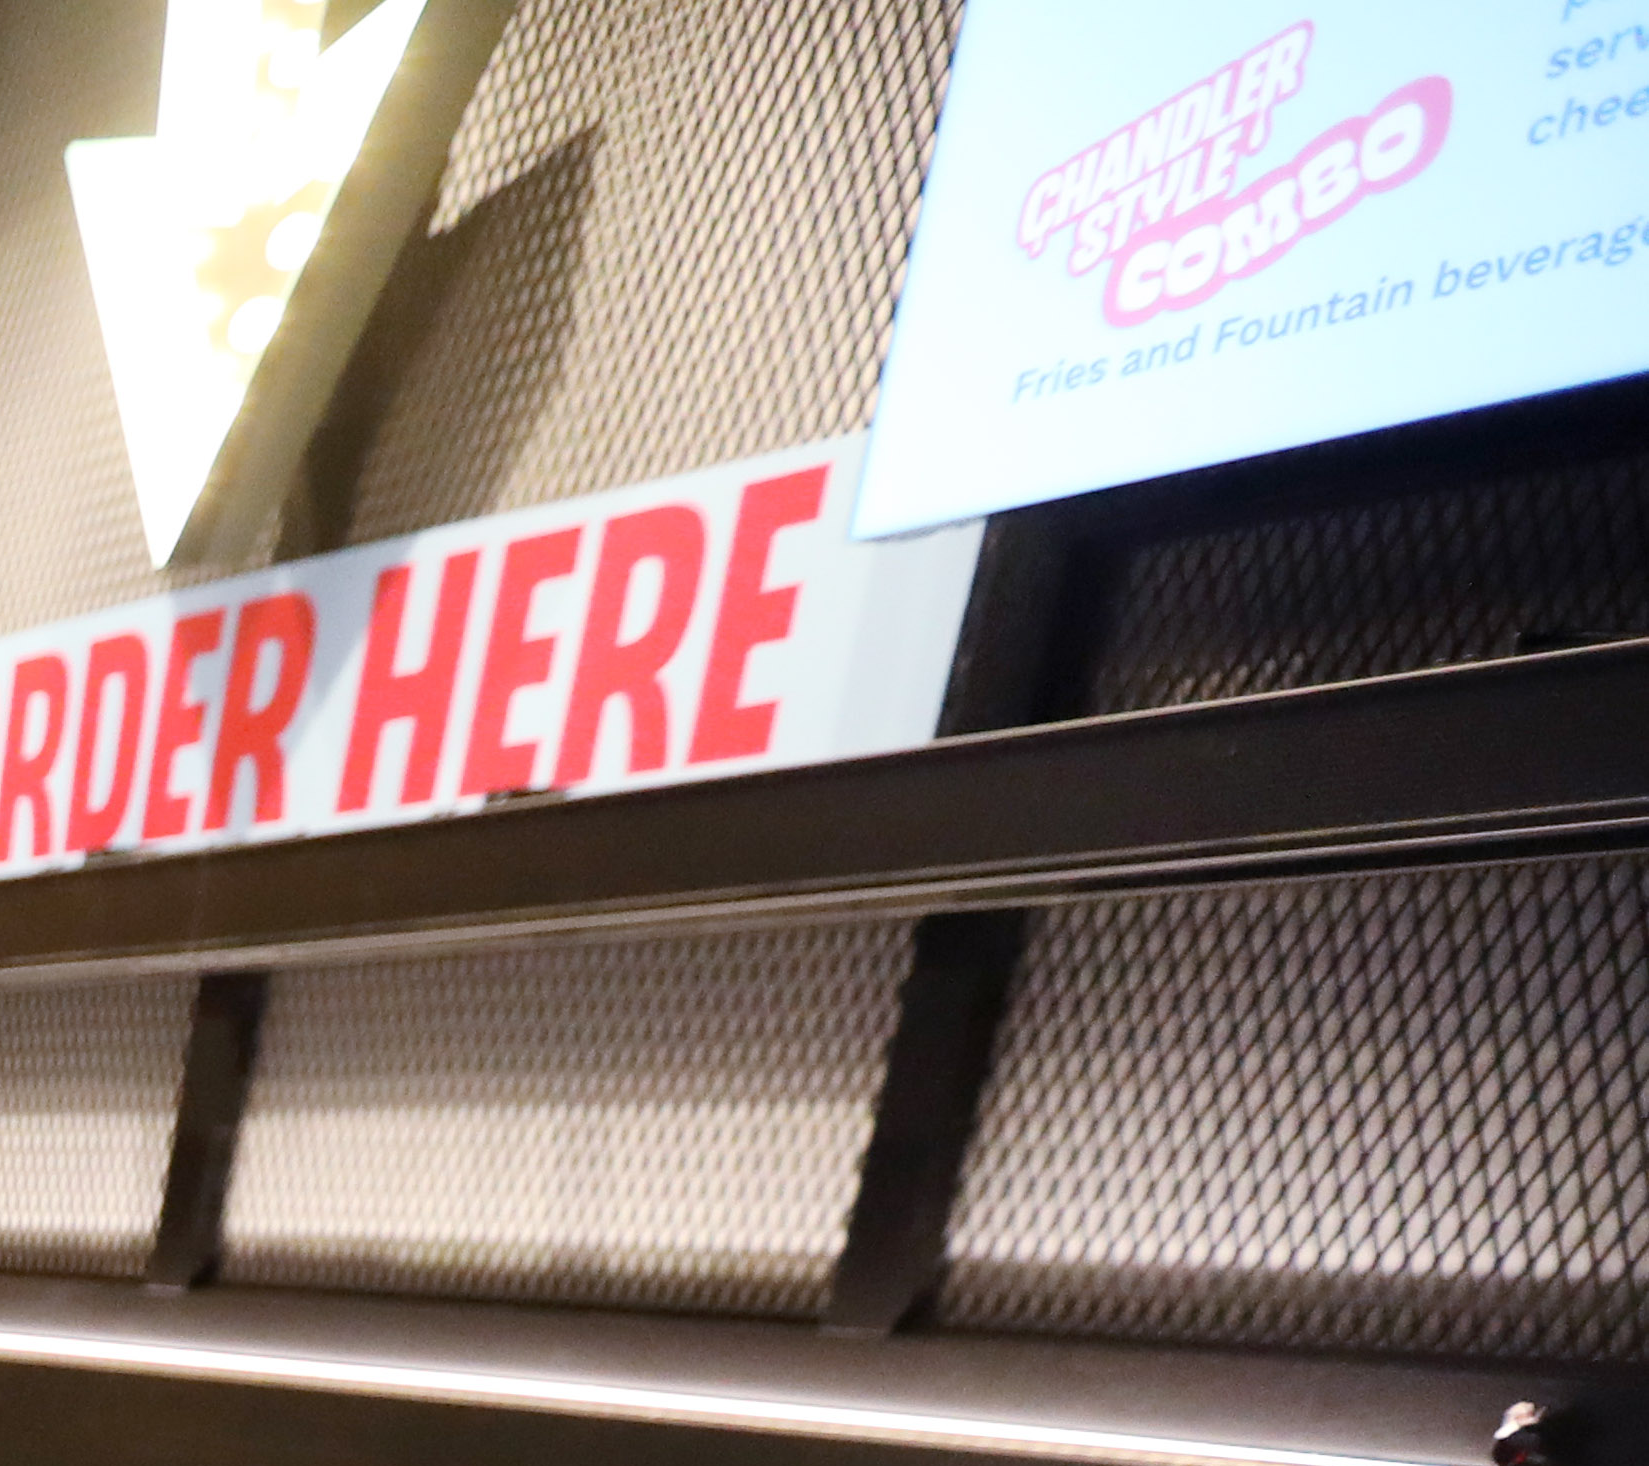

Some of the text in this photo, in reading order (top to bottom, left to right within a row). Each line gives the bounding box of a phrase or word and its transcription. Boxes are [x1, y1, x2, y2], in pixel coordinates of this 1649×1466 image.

[1019, 22, 1312, 242] CHANDLER
[1070, 126, 1243, 271] STYLE
[1113, 100, 1428, 314] COMBO
[1011, 356, 1108, 404] Fries
[1118, 324, 1202, 379] and
[1212, 277, 1416, 355] Fountain
[333, 460, 833, 815] HERE
